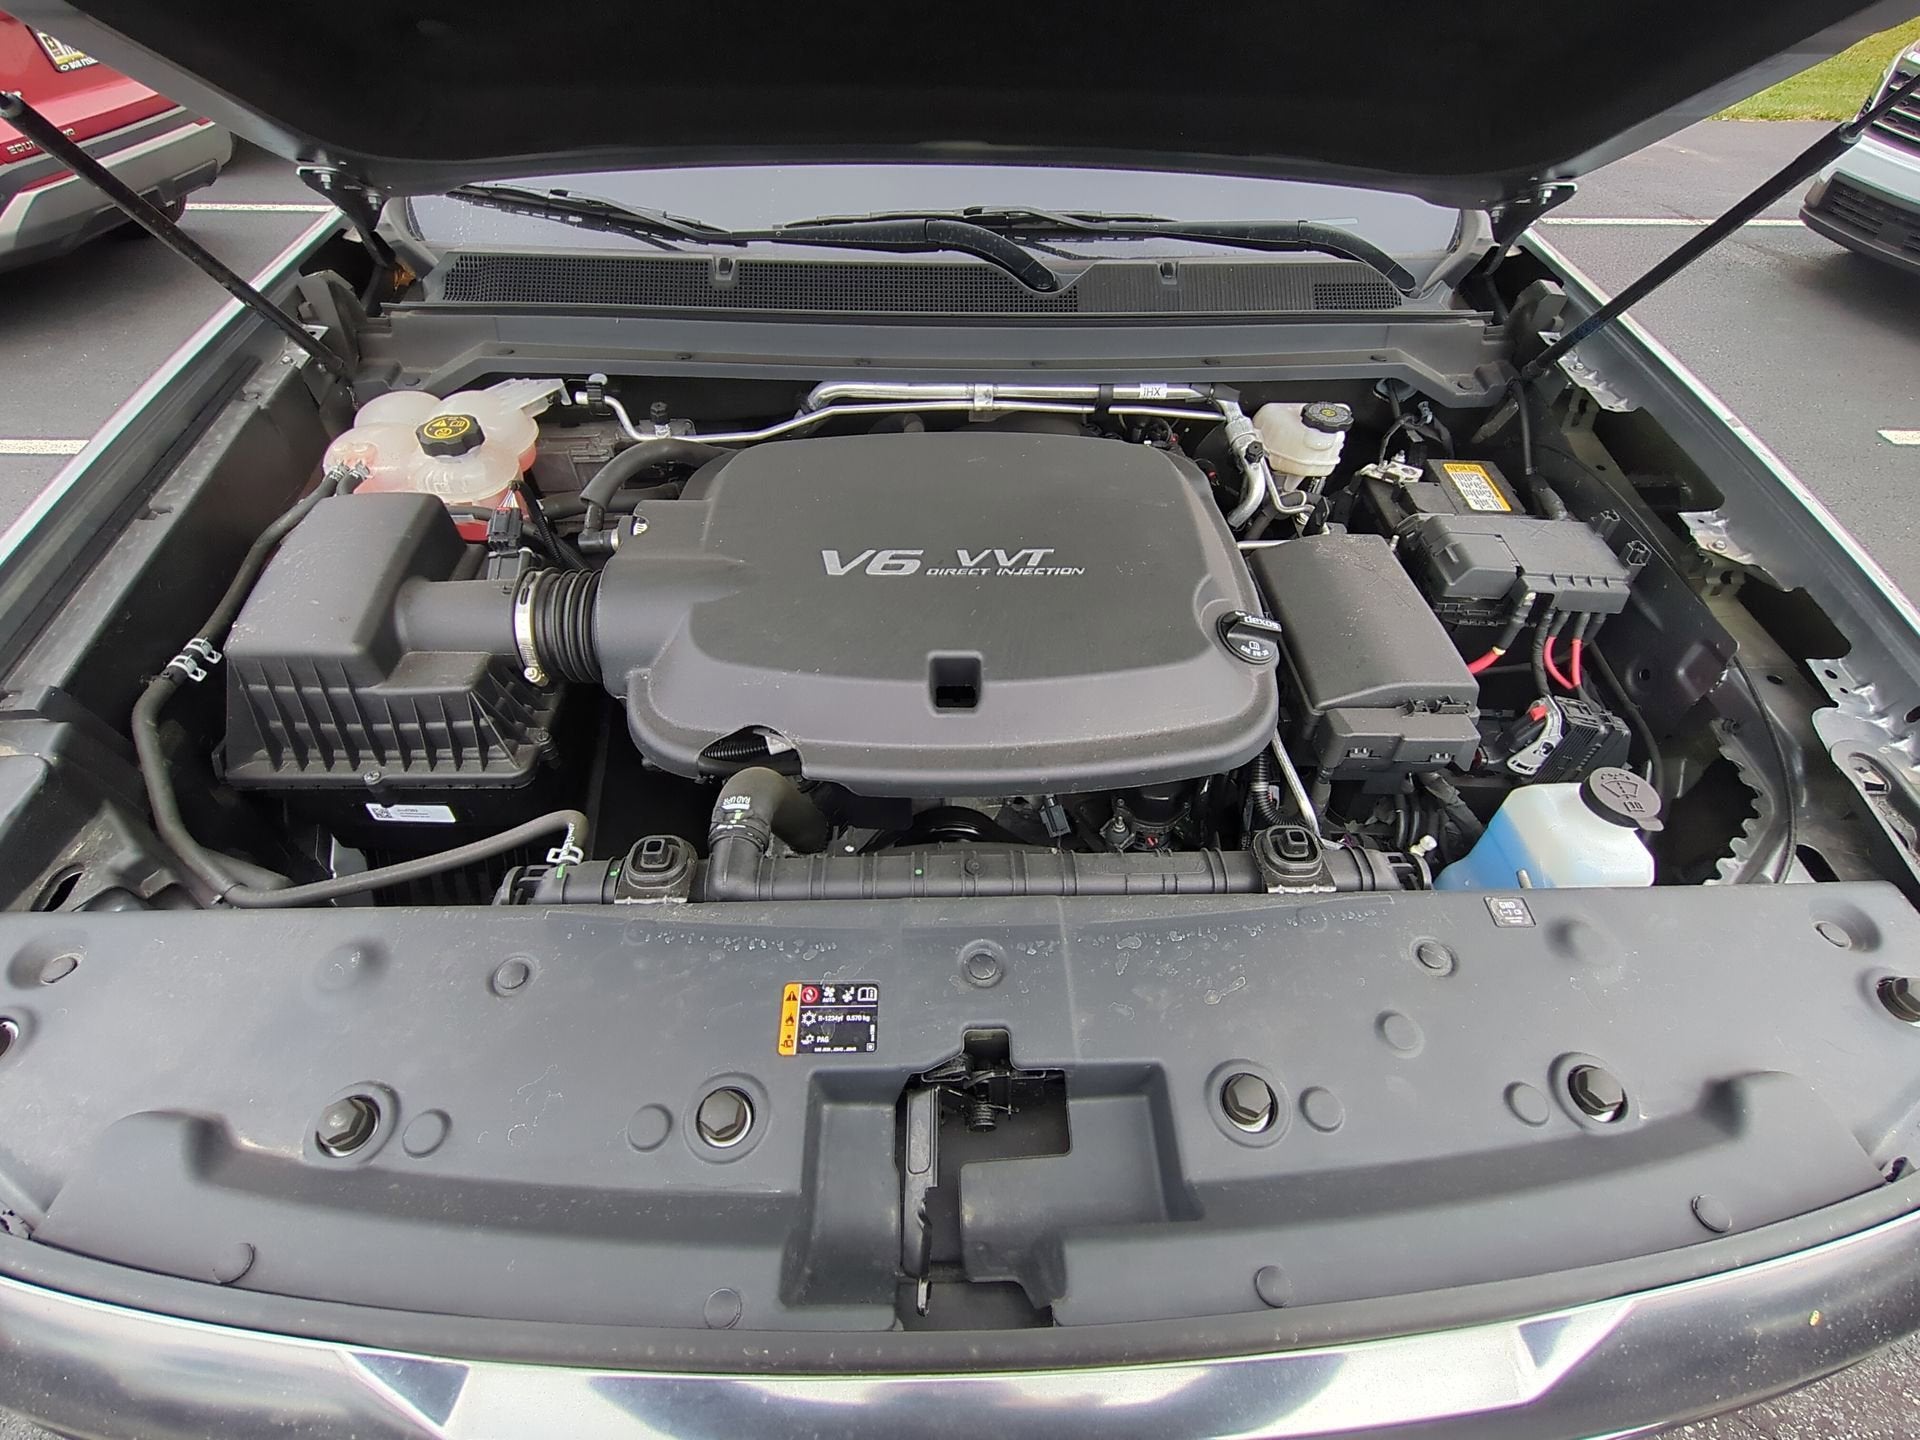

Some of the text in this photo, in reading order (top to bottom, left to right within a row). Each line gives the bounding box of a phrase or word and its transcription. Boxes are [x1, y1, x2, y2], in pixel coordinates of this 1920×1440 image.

[821, 548, 1055, 576] V6 VVT
[925, 567, 1086, 576] DIRECT INJECTION
[863, 1014, 870, 1022] kg
[816, 1035, 830, 1043] PAG
